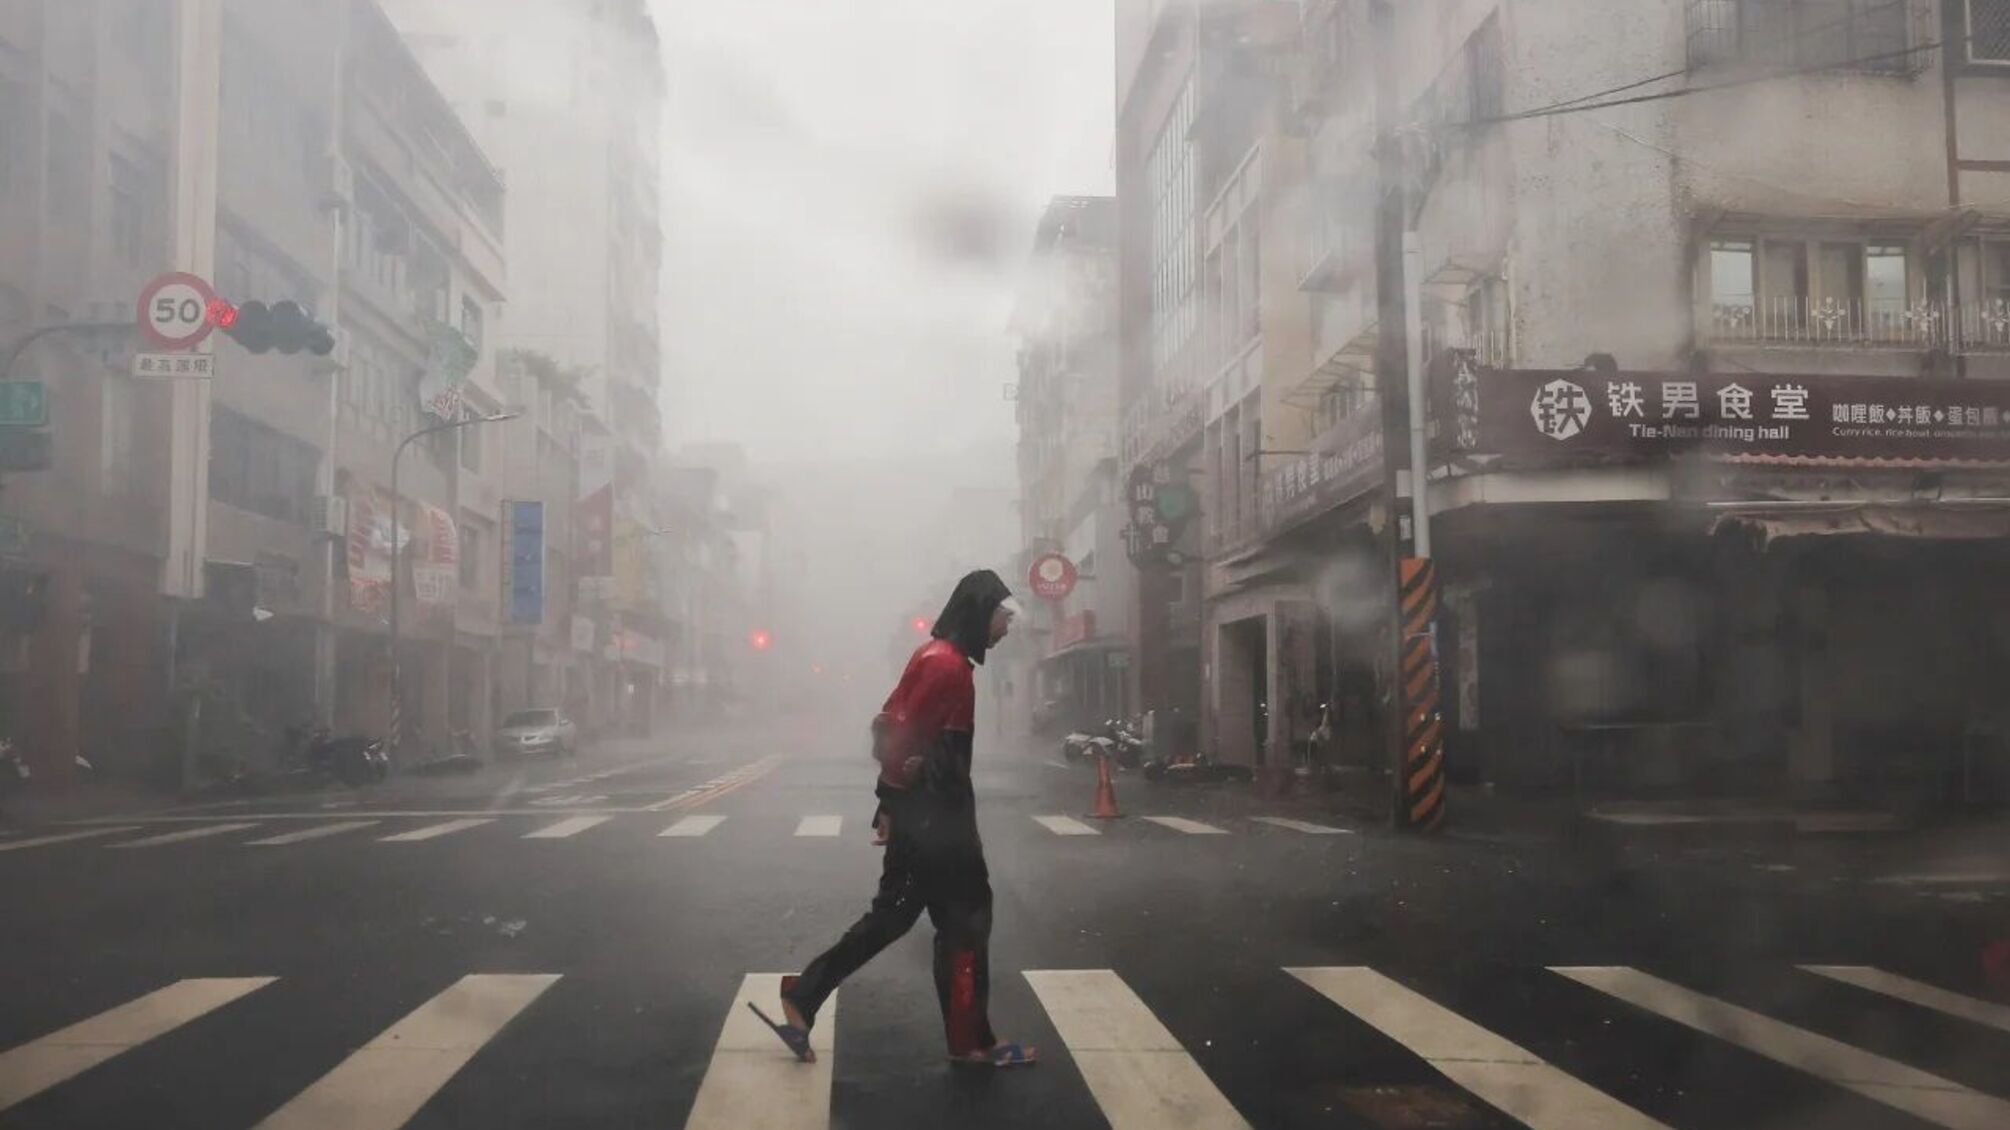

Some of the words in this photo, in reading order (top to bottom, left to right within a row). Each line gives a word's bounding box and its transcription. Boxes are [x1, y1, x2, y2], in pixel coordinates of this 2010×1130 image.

[156, 298, 200, 323] 50
[1536, 382, 1588, 436] 铁
[1607, 381, 1810, 419] 铁男食堂
[1702, 424, 1754, 442] dining
[1758, 425, 1789, 439] hall
[1832, 427, 1860, 438] Curry
